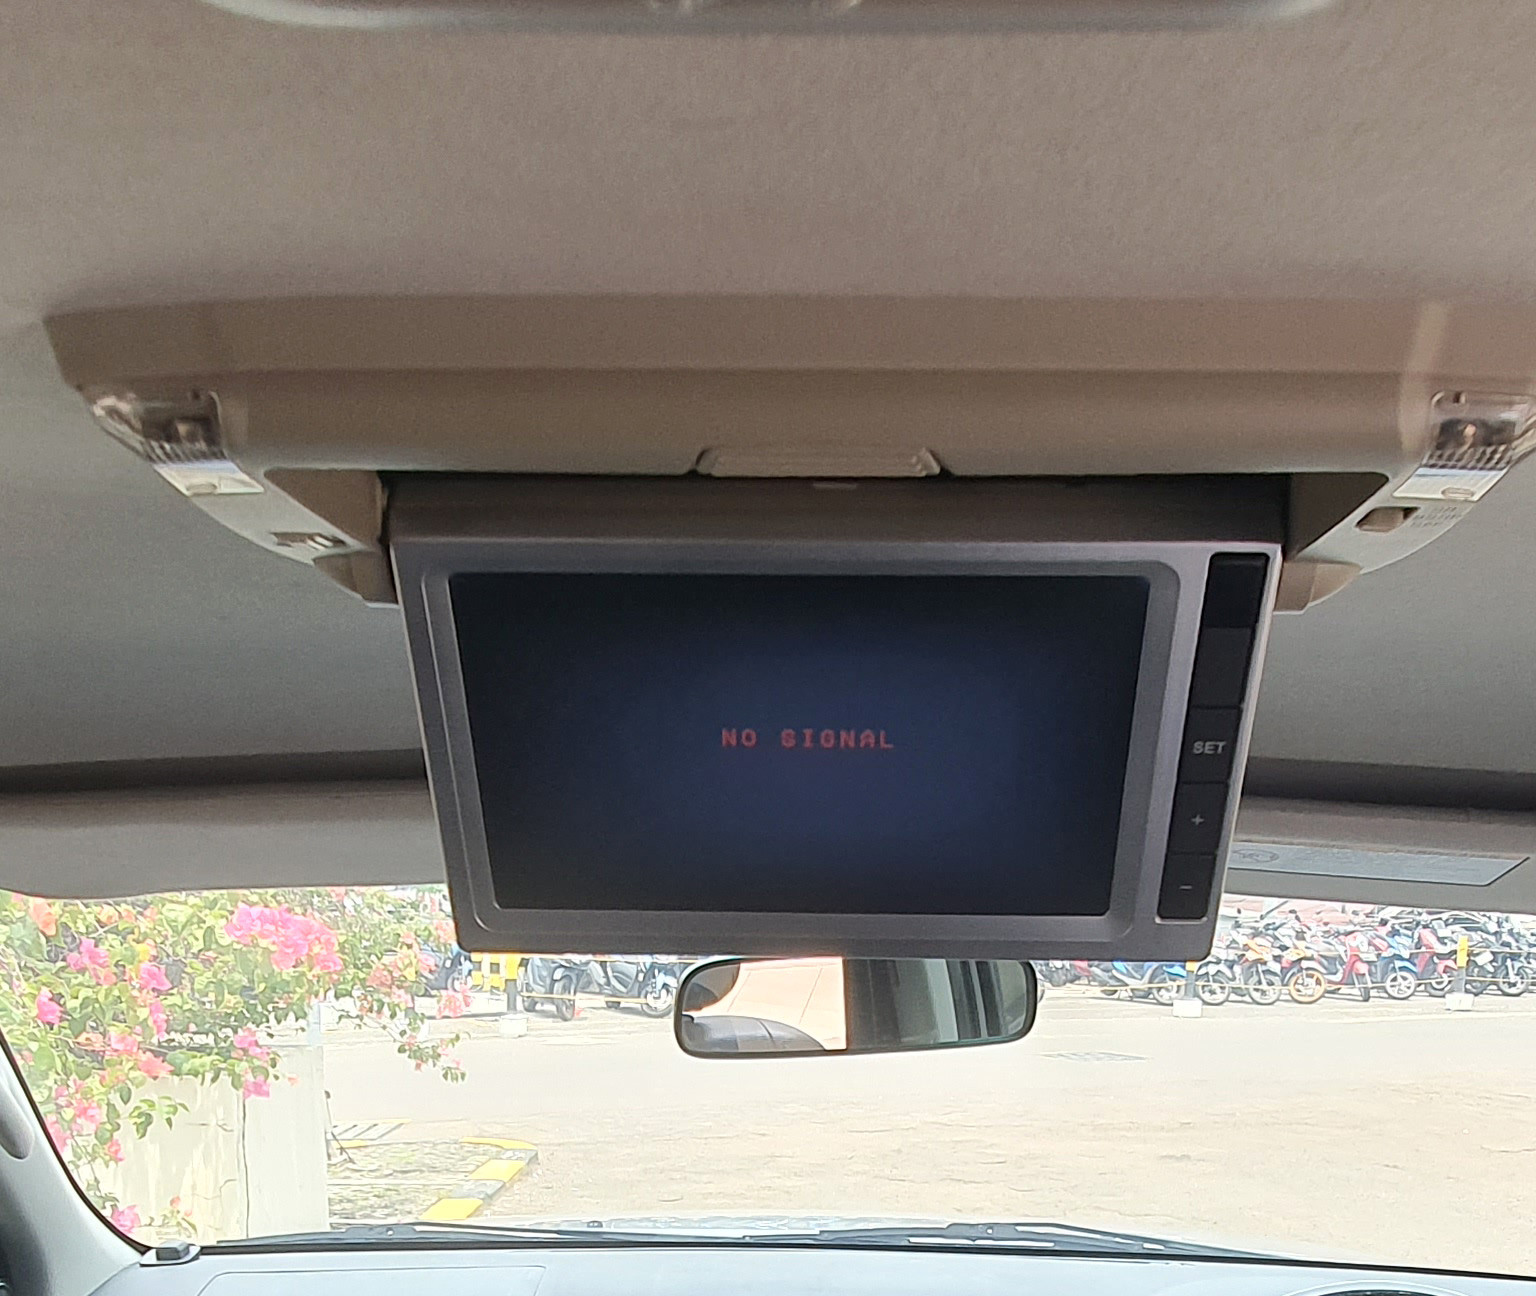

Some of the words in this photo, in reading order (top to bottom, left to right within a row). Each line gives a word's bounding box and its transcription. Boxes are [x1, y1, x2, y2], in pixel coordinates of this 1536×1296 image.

[721, 728, 757, 748] NO
[780, 728, 894, 749] SIGNAL
[1193, 740, 1227, 755] SET
